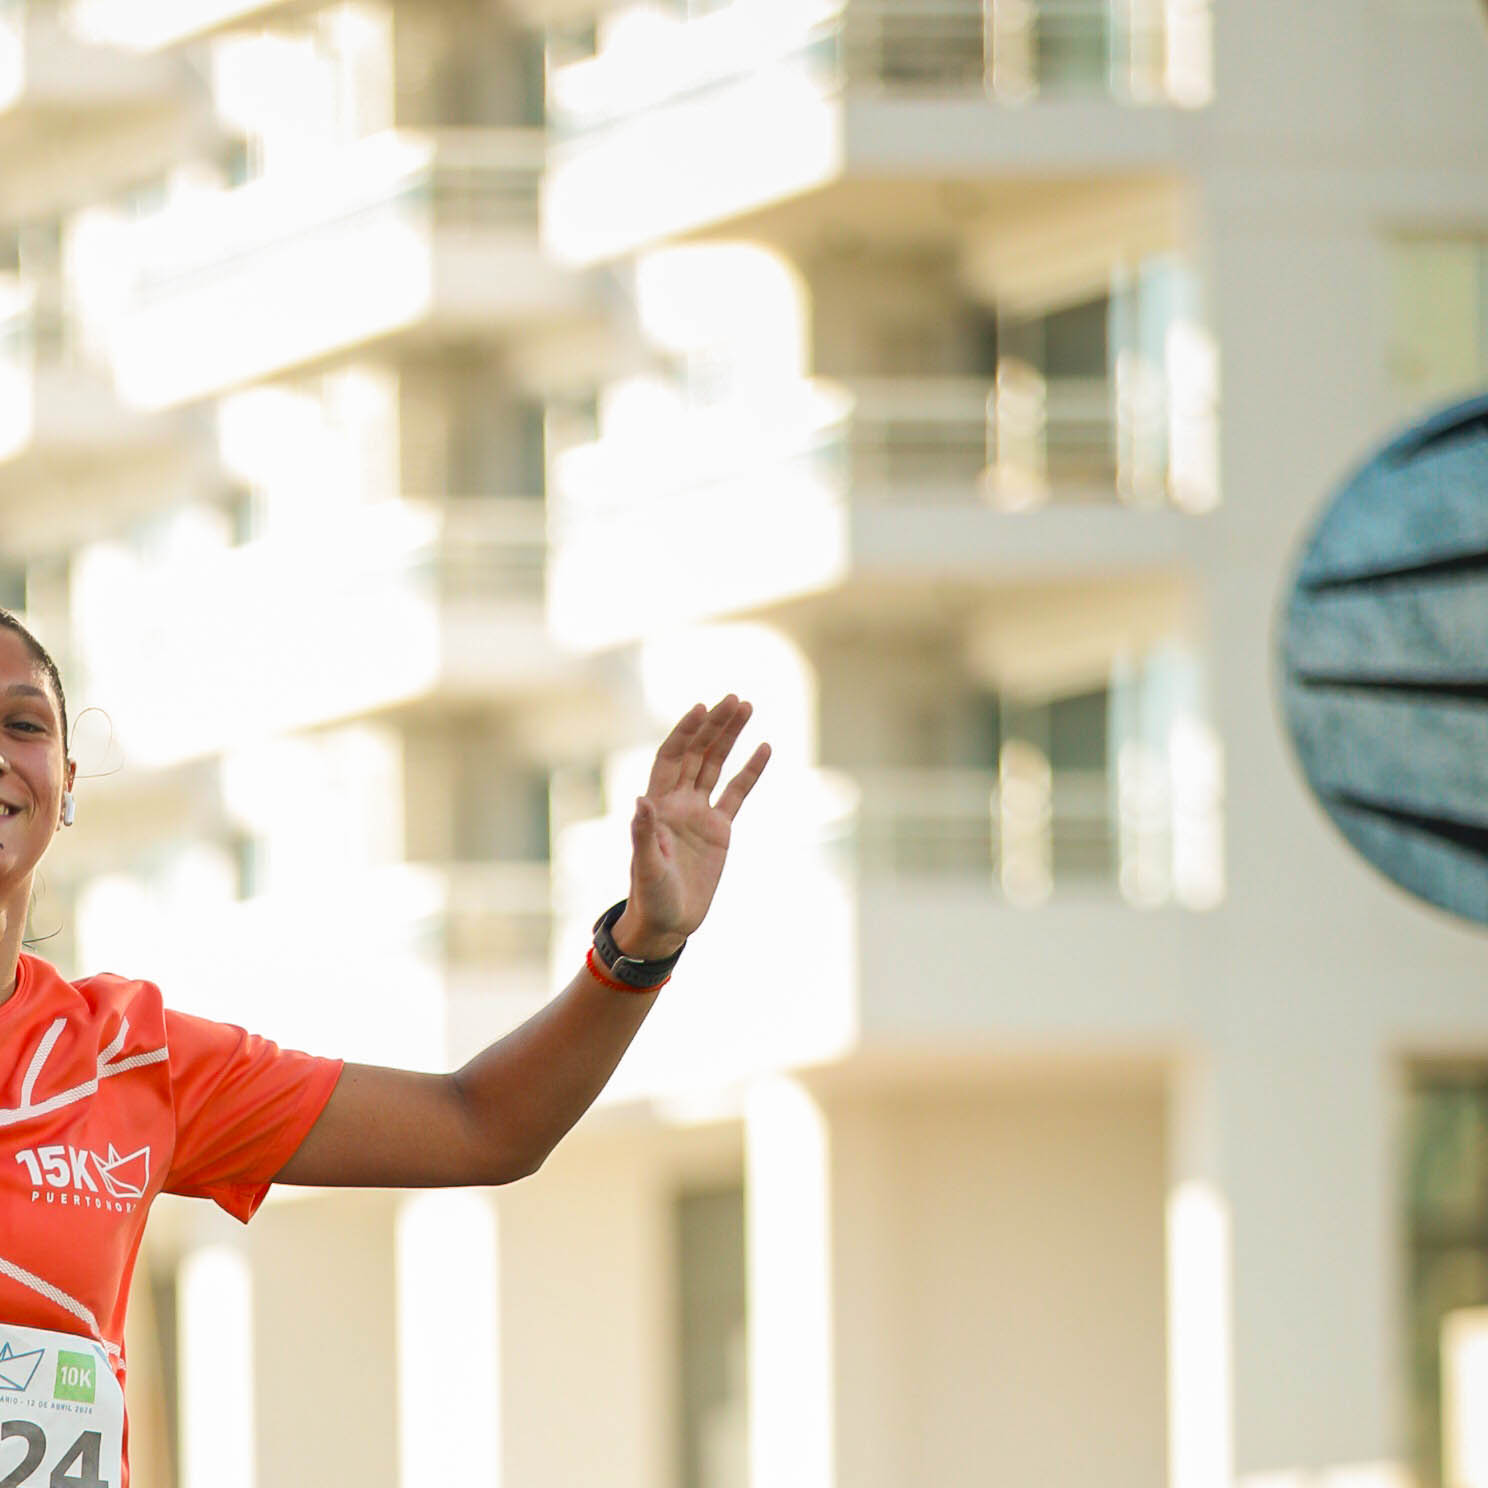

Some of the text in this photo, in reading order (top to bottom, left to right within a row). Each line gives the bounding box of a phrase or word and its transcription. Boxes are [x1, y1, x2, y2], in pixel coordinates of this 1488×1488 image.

[15, 1145, 99, 1193] 15K
[60, 1366, 93, 1389] 10K
[38, 1401, 48, 1409] DE
[50, 1403, 73, 1412] ABRIL
